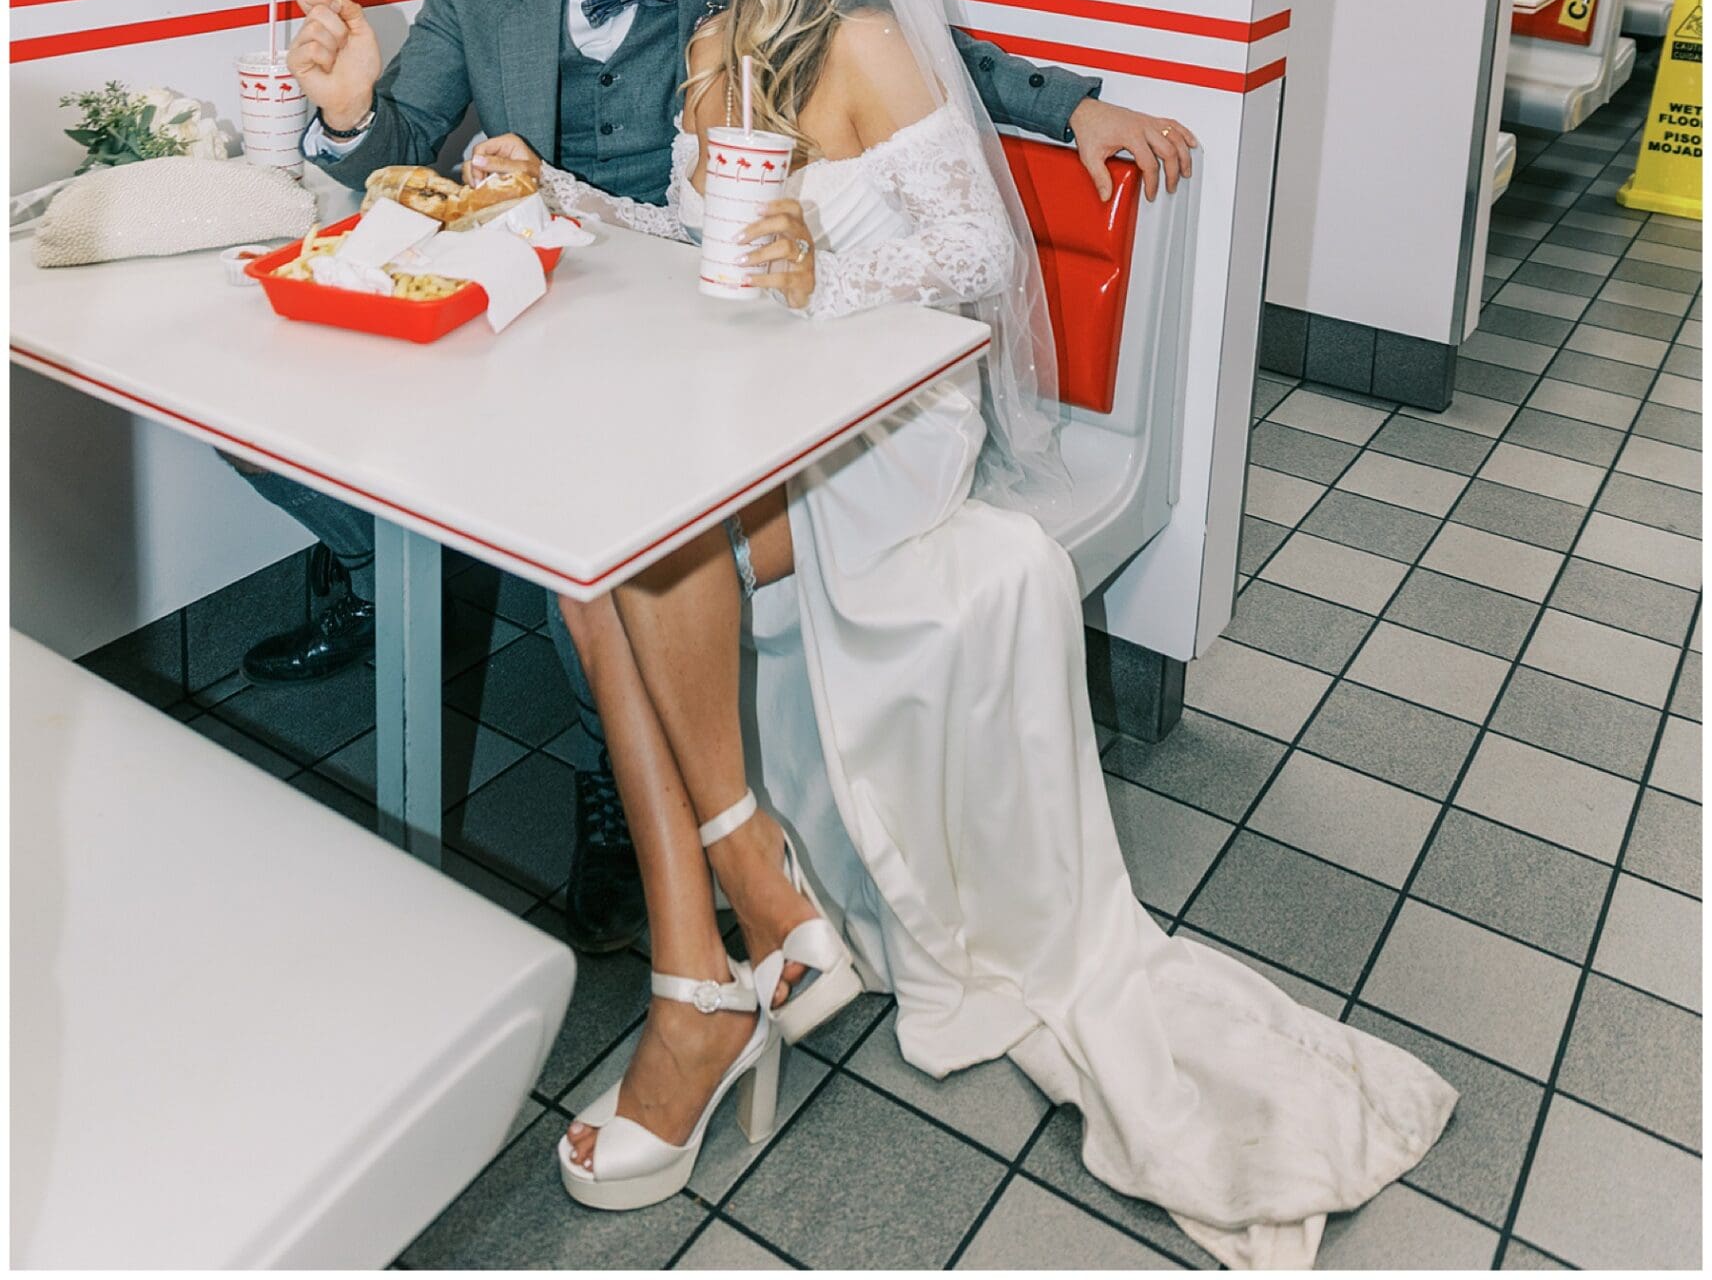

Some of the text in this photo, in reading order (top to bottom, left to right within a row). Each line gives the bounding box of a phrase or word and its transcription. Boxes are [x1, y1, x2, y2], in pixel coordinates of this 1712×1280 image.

[1669, 102, 1702, 115] WET
[1659, 113, 1702, 128] FLOO
[1664, 131, 1702, 145] PISO
[1648, 141, 1702, 158] MOJAD
